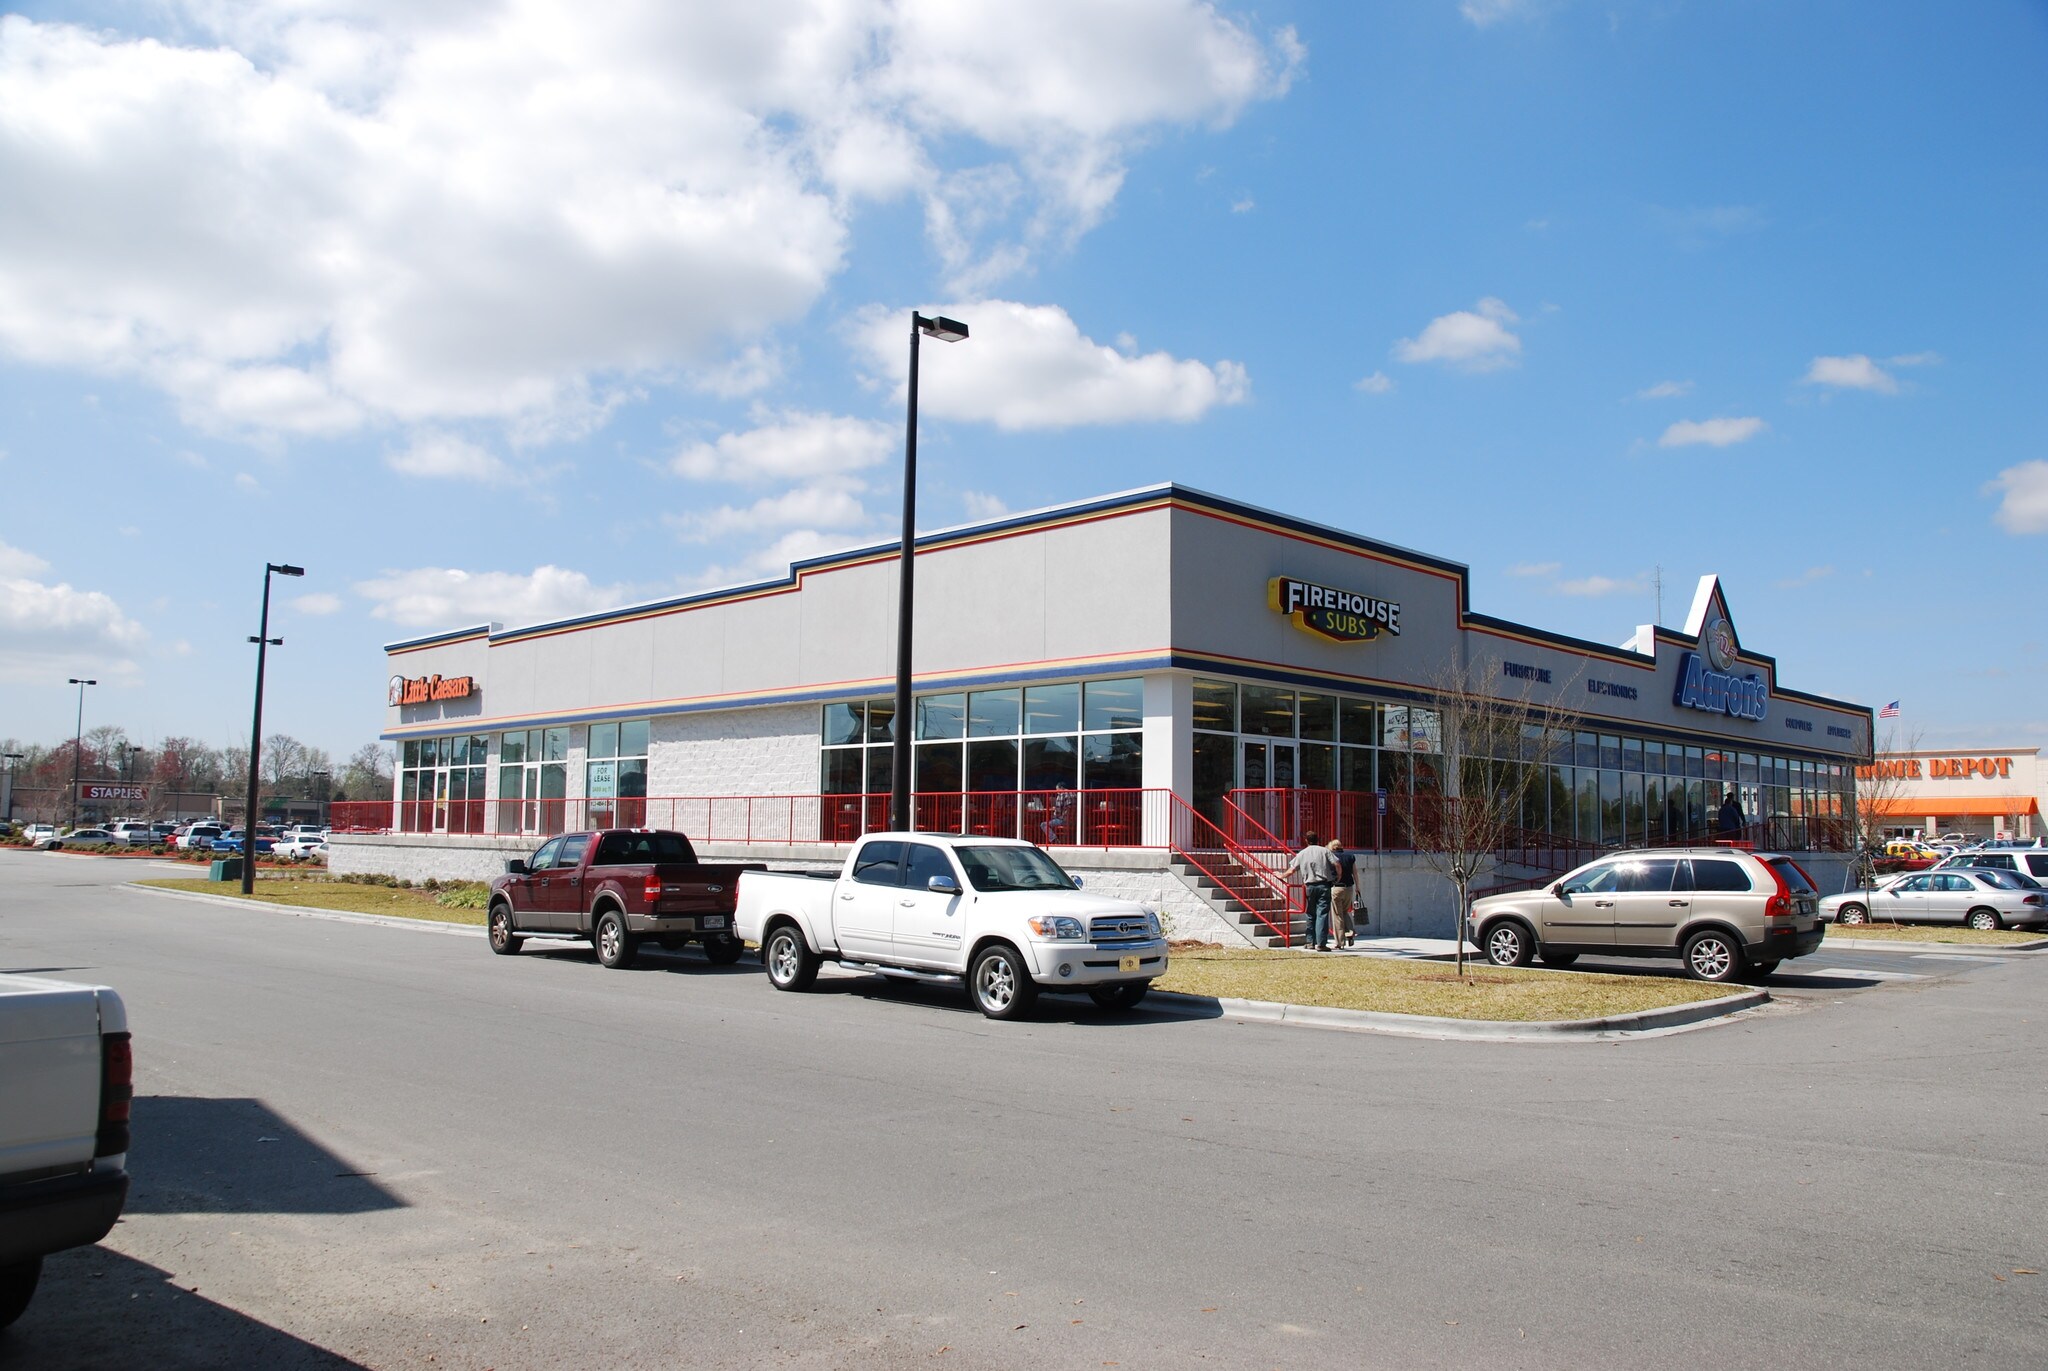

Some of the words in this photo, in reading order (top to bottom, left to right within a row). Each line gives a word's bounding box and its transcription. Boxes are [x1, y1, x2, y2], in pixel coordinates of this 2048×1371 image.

[1287, 581, 1400, 635] FIREHOUSE
[1326, 611, 1367, 637] SUBS
[1503, 661, 1552, 684] FURNITURE
[402, 676, 428, 704] Little
[430, 674, 470, 700] Caesars
[1587, 679, 1638, 700] ELECTRONICS
[1680, 653, 1768, 721] Aaron's
[593, 775, 611, 783] LEASE
[1929, 757, 2012, 778] DEPOT
[90, 787, 142, 799] STAPLES
